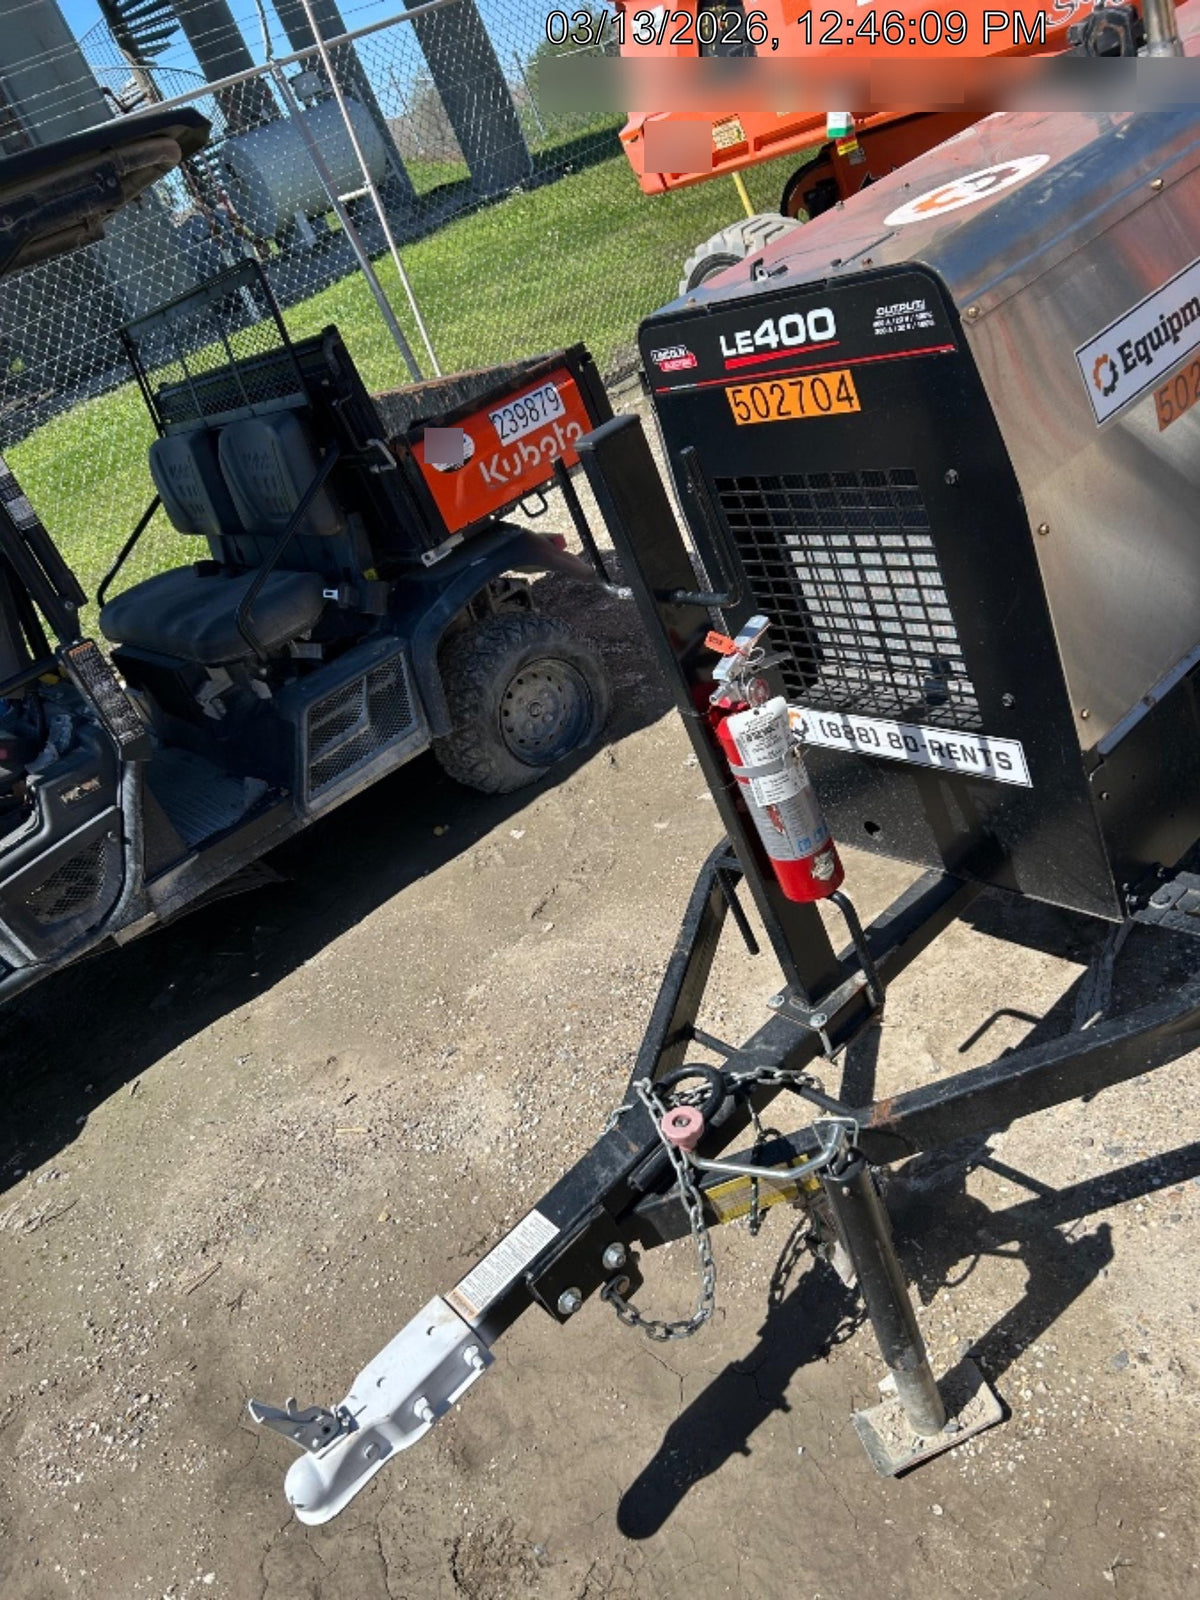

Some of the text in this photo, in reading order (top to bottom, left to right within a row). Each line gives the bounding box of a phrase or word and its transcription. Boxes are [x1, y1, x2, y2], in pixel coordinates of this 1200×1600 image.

[719, 307, 837, 357] LE400
[491, 386, 560, 440] 239879
[730, 373, 855, 422] 502704
[818, 719, 879, 748] (888)
[886, 731, 1013, 771] 80-RENTS
